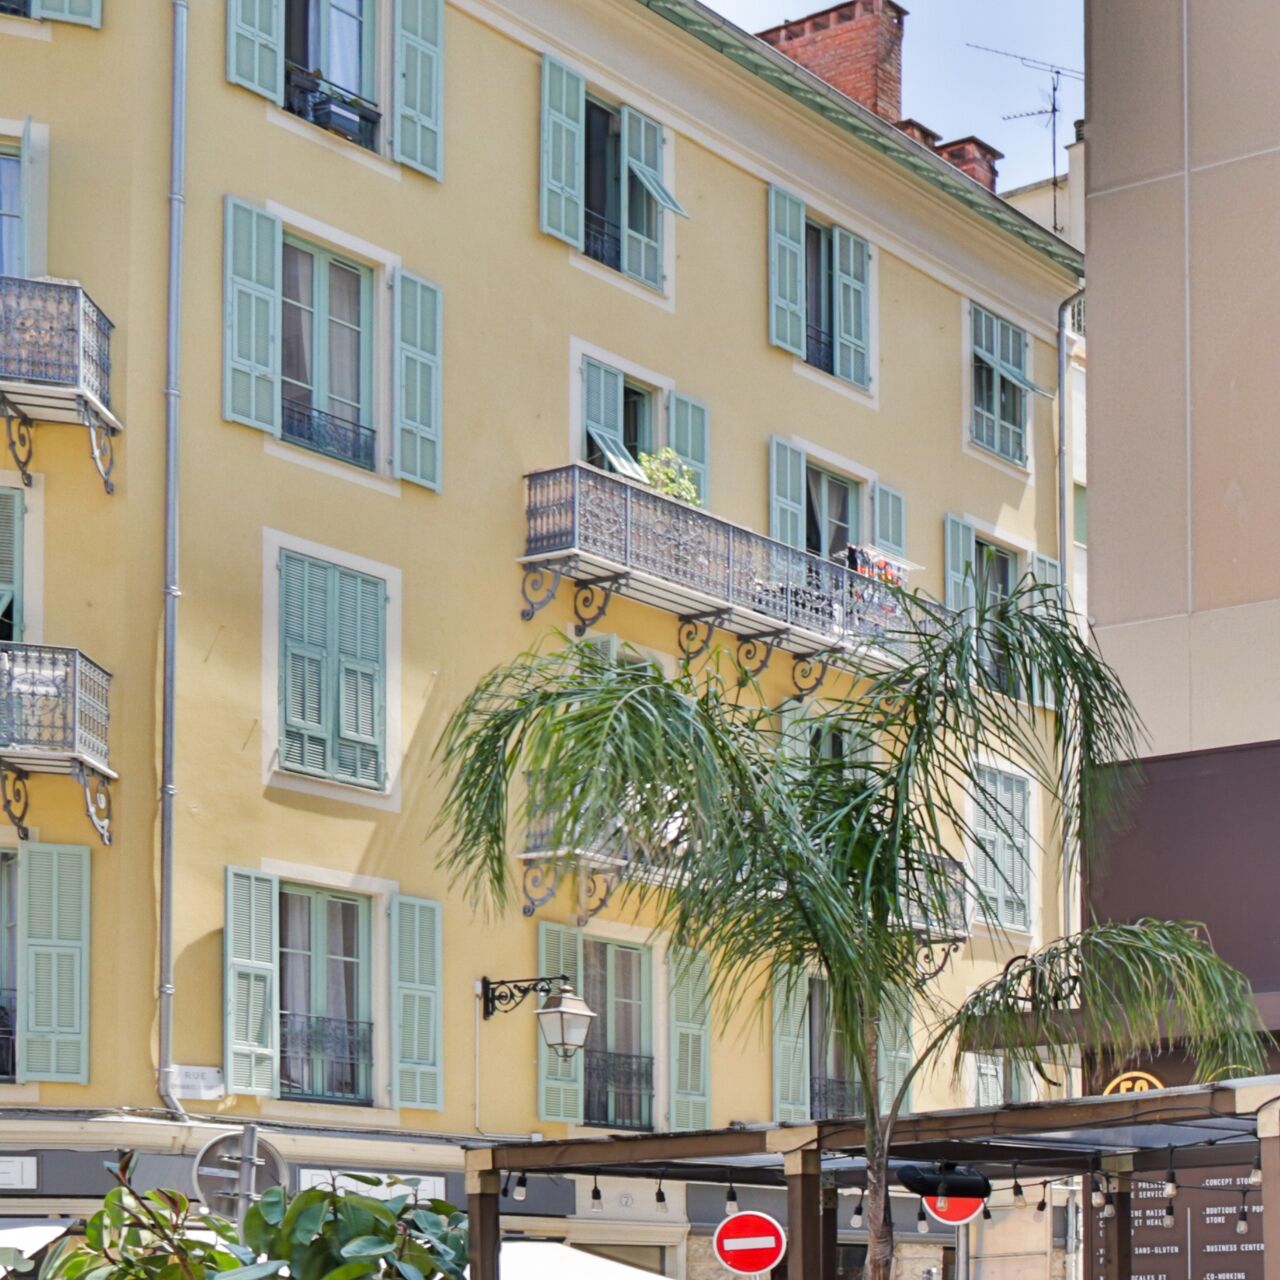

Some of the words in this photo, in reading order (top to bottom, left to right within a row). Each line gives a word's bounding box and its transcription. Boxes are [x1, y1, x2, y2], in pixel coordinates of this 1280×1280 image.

[184, 1071, 208, 1080] RUE
[1146, 1208, 1167, 1217] MAISO
[1205, 1216, 1226, 1224] STORE
[1134, 1246, 1179, 1254] SANS-GLUTEN
